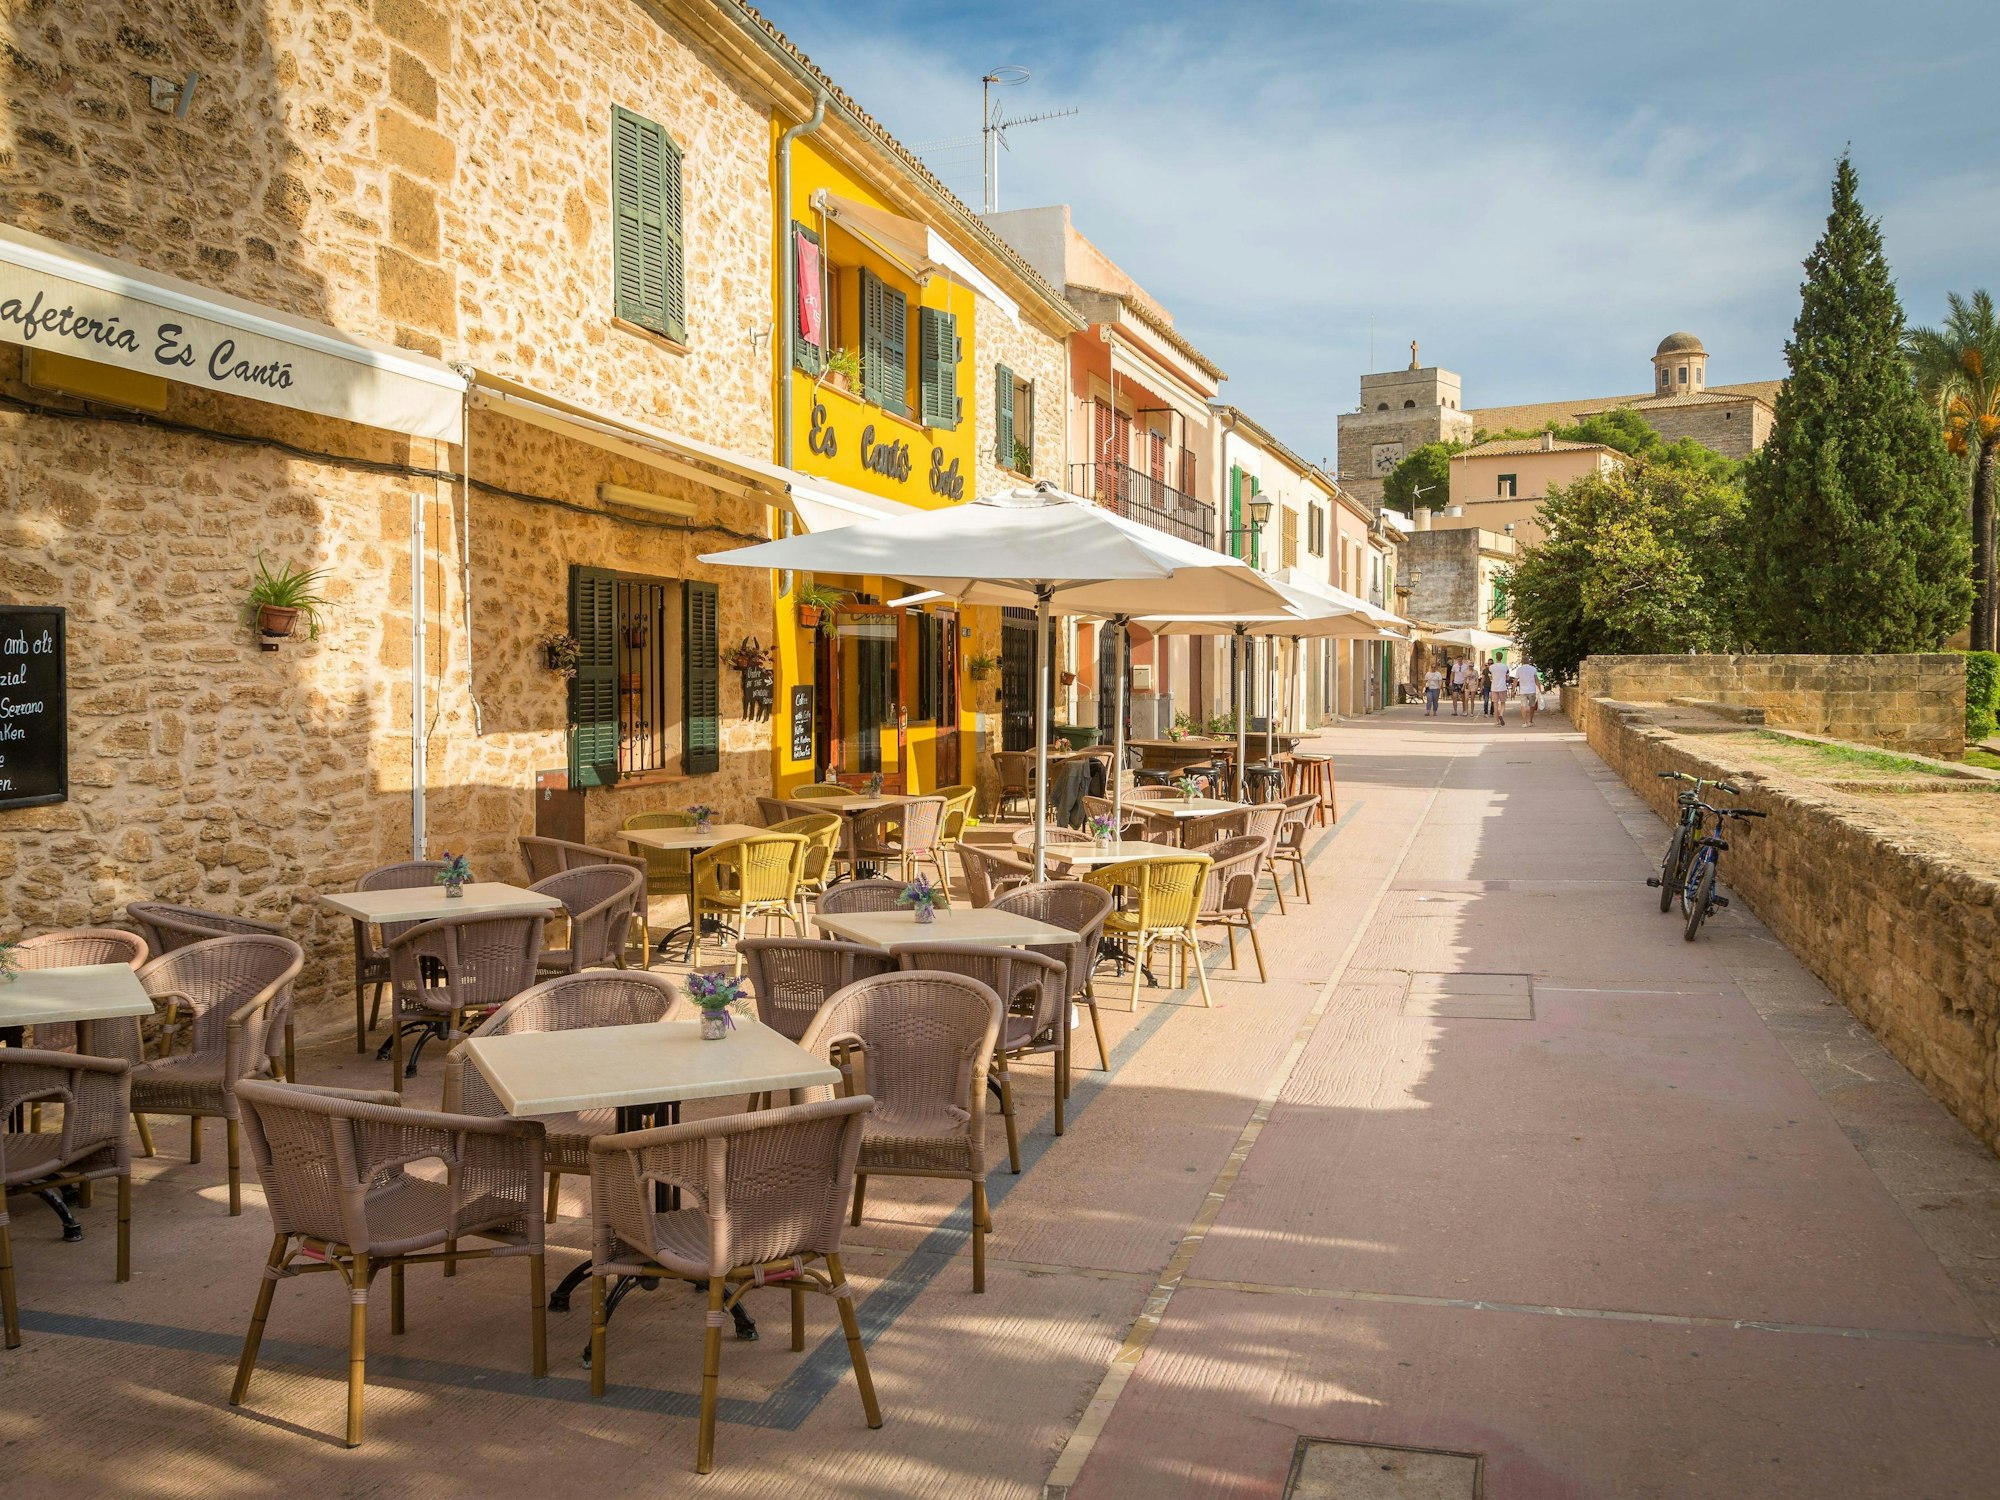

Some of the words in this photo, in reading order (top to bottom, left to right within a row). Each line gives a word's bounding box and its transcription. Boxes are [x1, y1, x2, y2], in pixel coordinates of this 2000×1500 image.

[154, 324, 196, 367] Es
[208, 339, 293, 390] Cantó
[808, 403, 838, 458] Es
[860, 424, 912, 484] Cantó
[4, 629, 29, 655] amb
[33, 629, 53, 654] oli
[0, 697, 44, 719] Serrano
